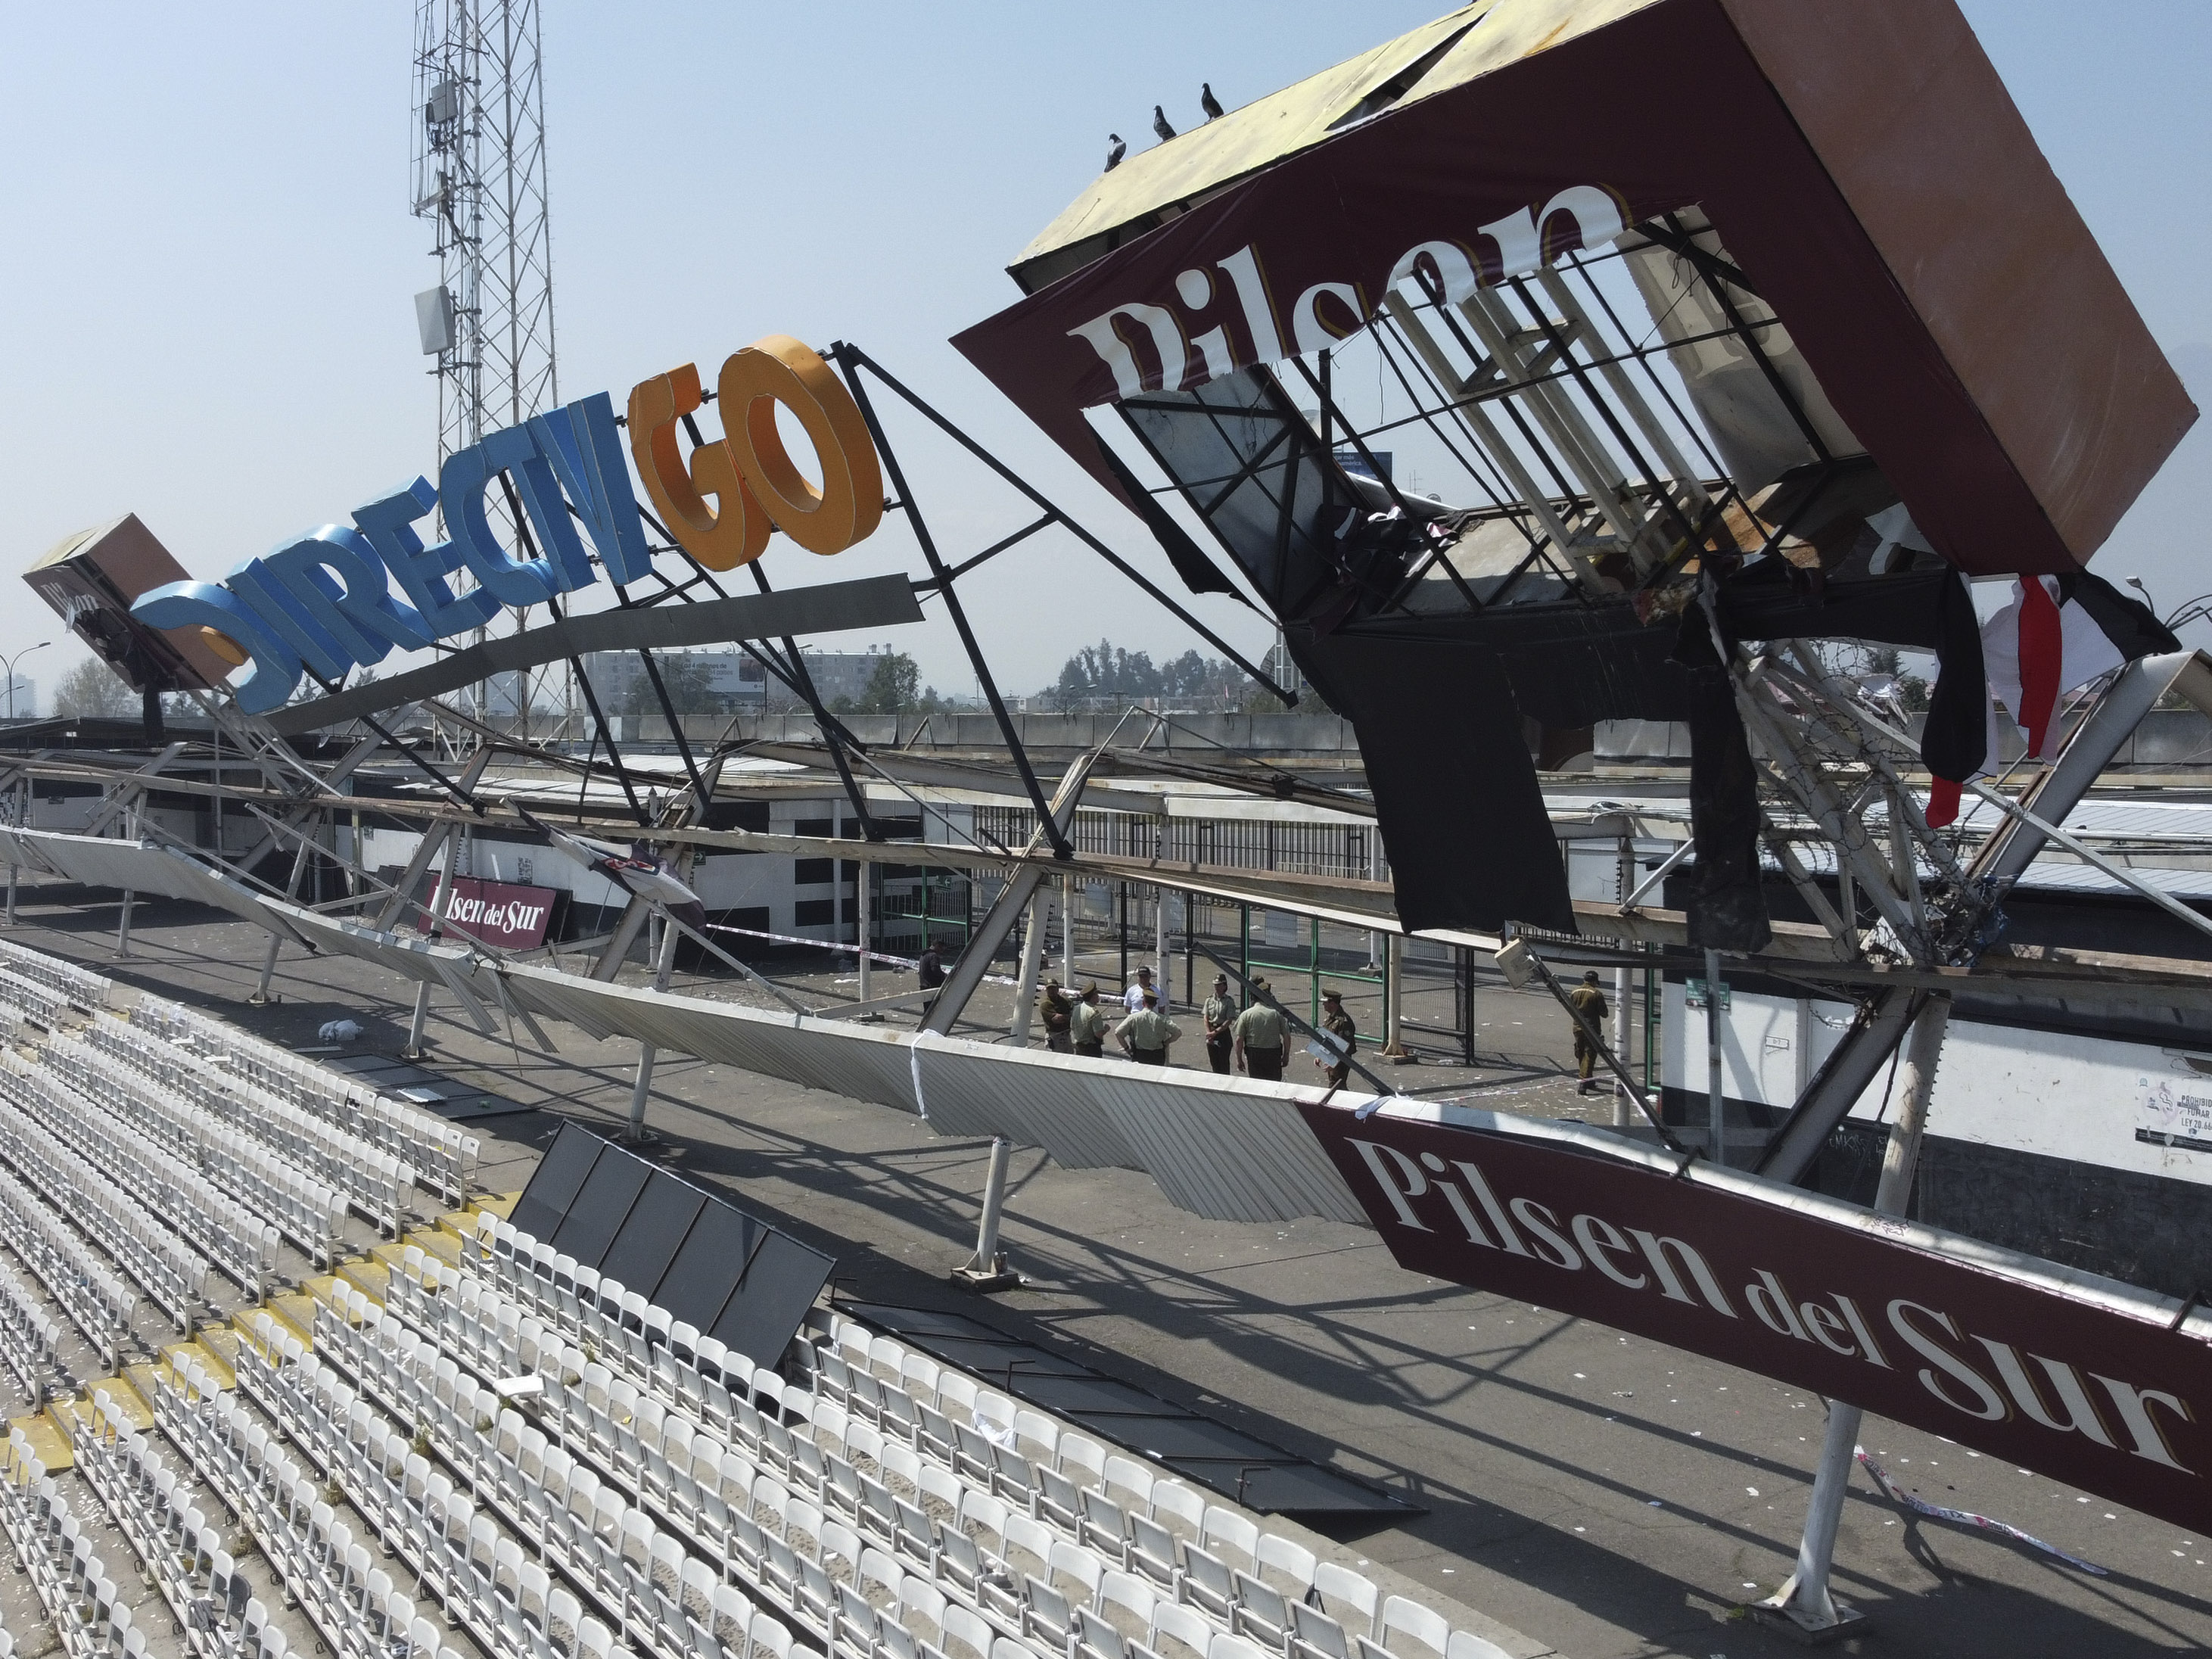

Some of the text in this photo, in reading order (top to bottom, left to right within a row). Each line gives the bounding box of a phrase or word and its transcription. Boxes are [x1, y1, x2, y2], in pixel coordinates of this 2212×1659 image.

[627, 333, 884, 572] GO
[429, 886, 544, 934] lsen del Sur
[2181, 1117, 2193, 1127] LEY
[2187, 1107, 2210, 1119] FUMAR
[1342, 1137, 2199, 1477] Pilsen del Sur
